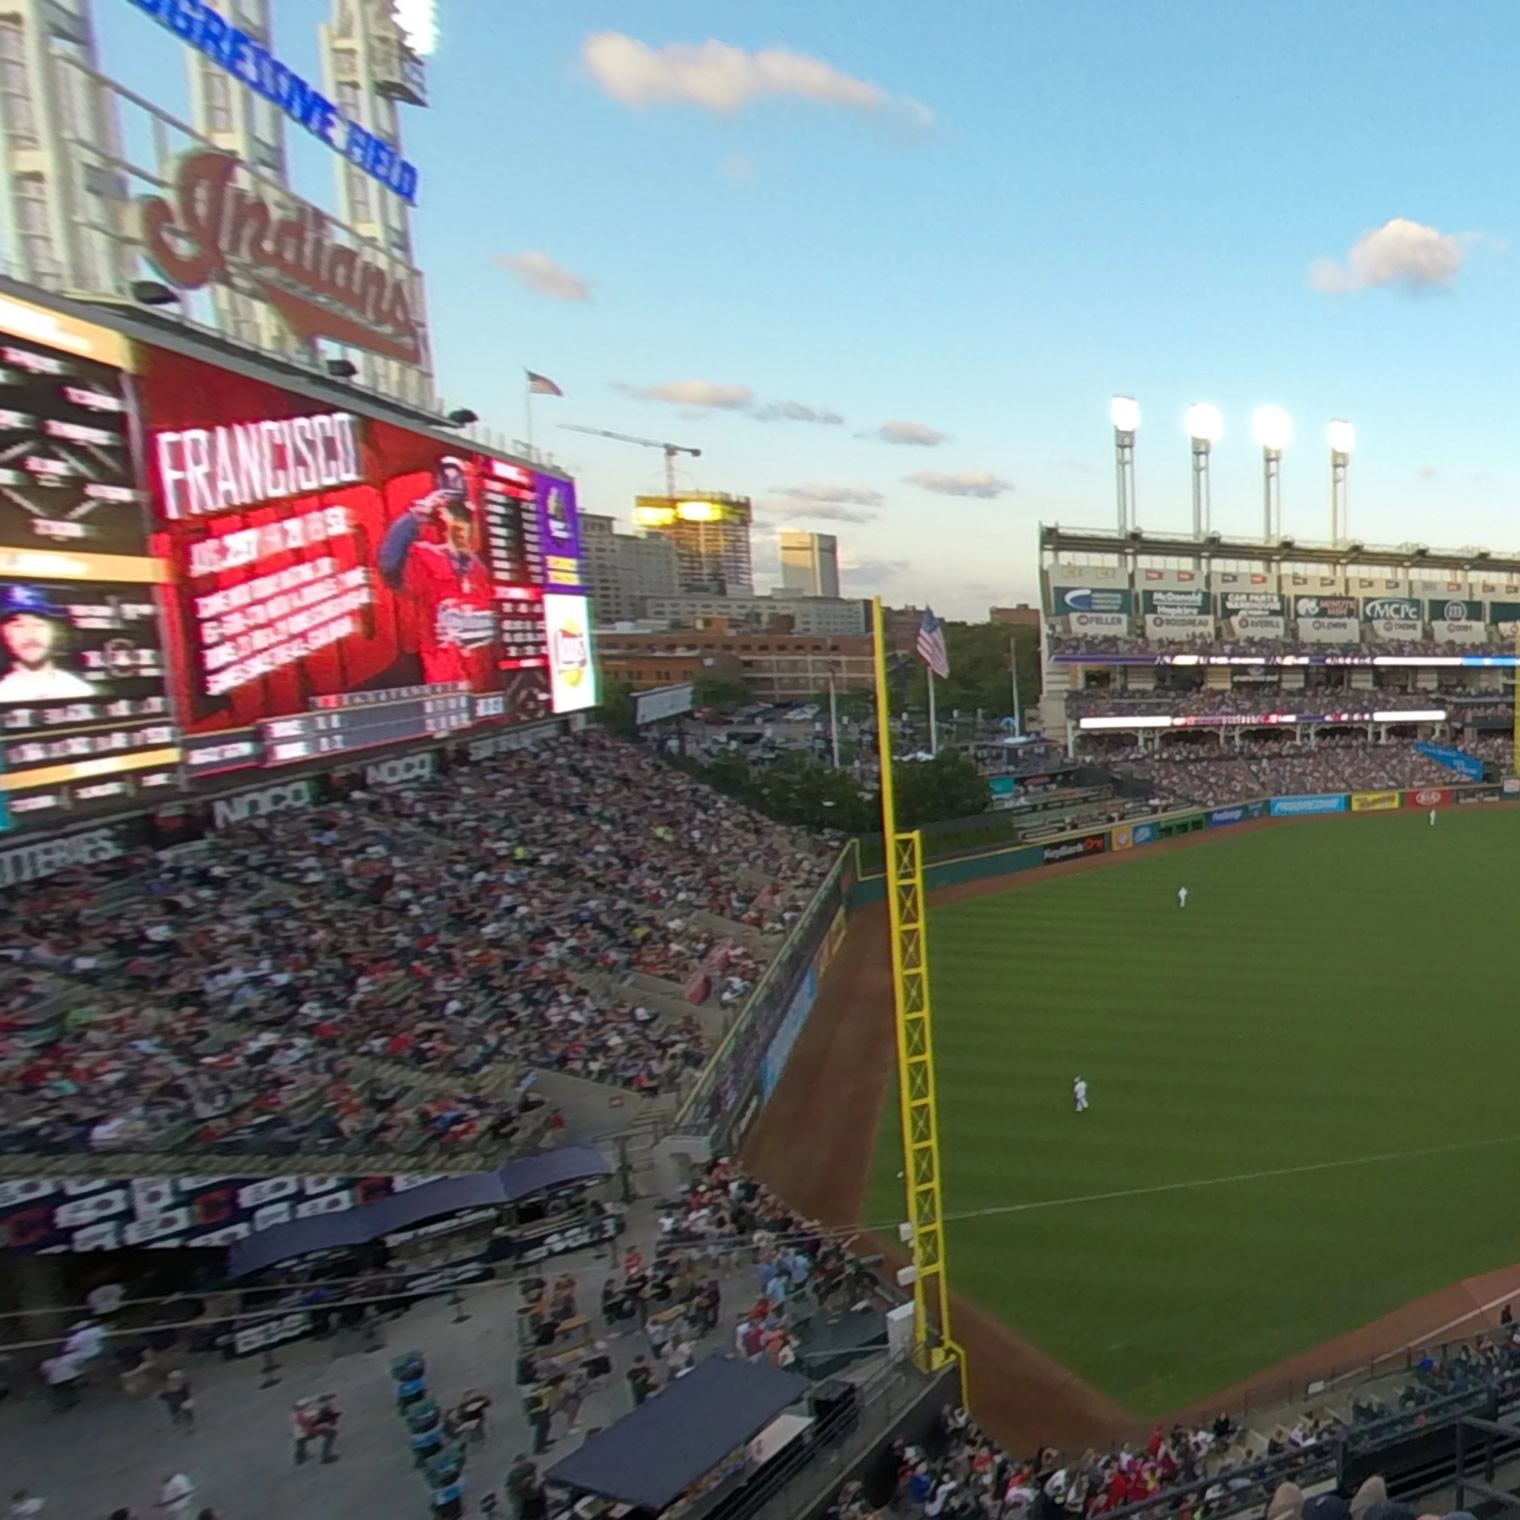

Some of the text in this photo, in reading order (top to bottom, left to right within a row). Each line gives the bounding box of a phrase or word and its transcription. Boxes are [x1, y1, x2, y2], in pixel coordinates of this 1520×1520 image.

[141, 152, 420, 362] Indians
[157, 412, 361, 519] FRANCISCO
[1089, 616, 1122, 626] FELLER
[1366, 603, 1418, 619] MCPc
[366, 754, 434, 785] NOCO
[213, 781, 311, 829] NOCO
